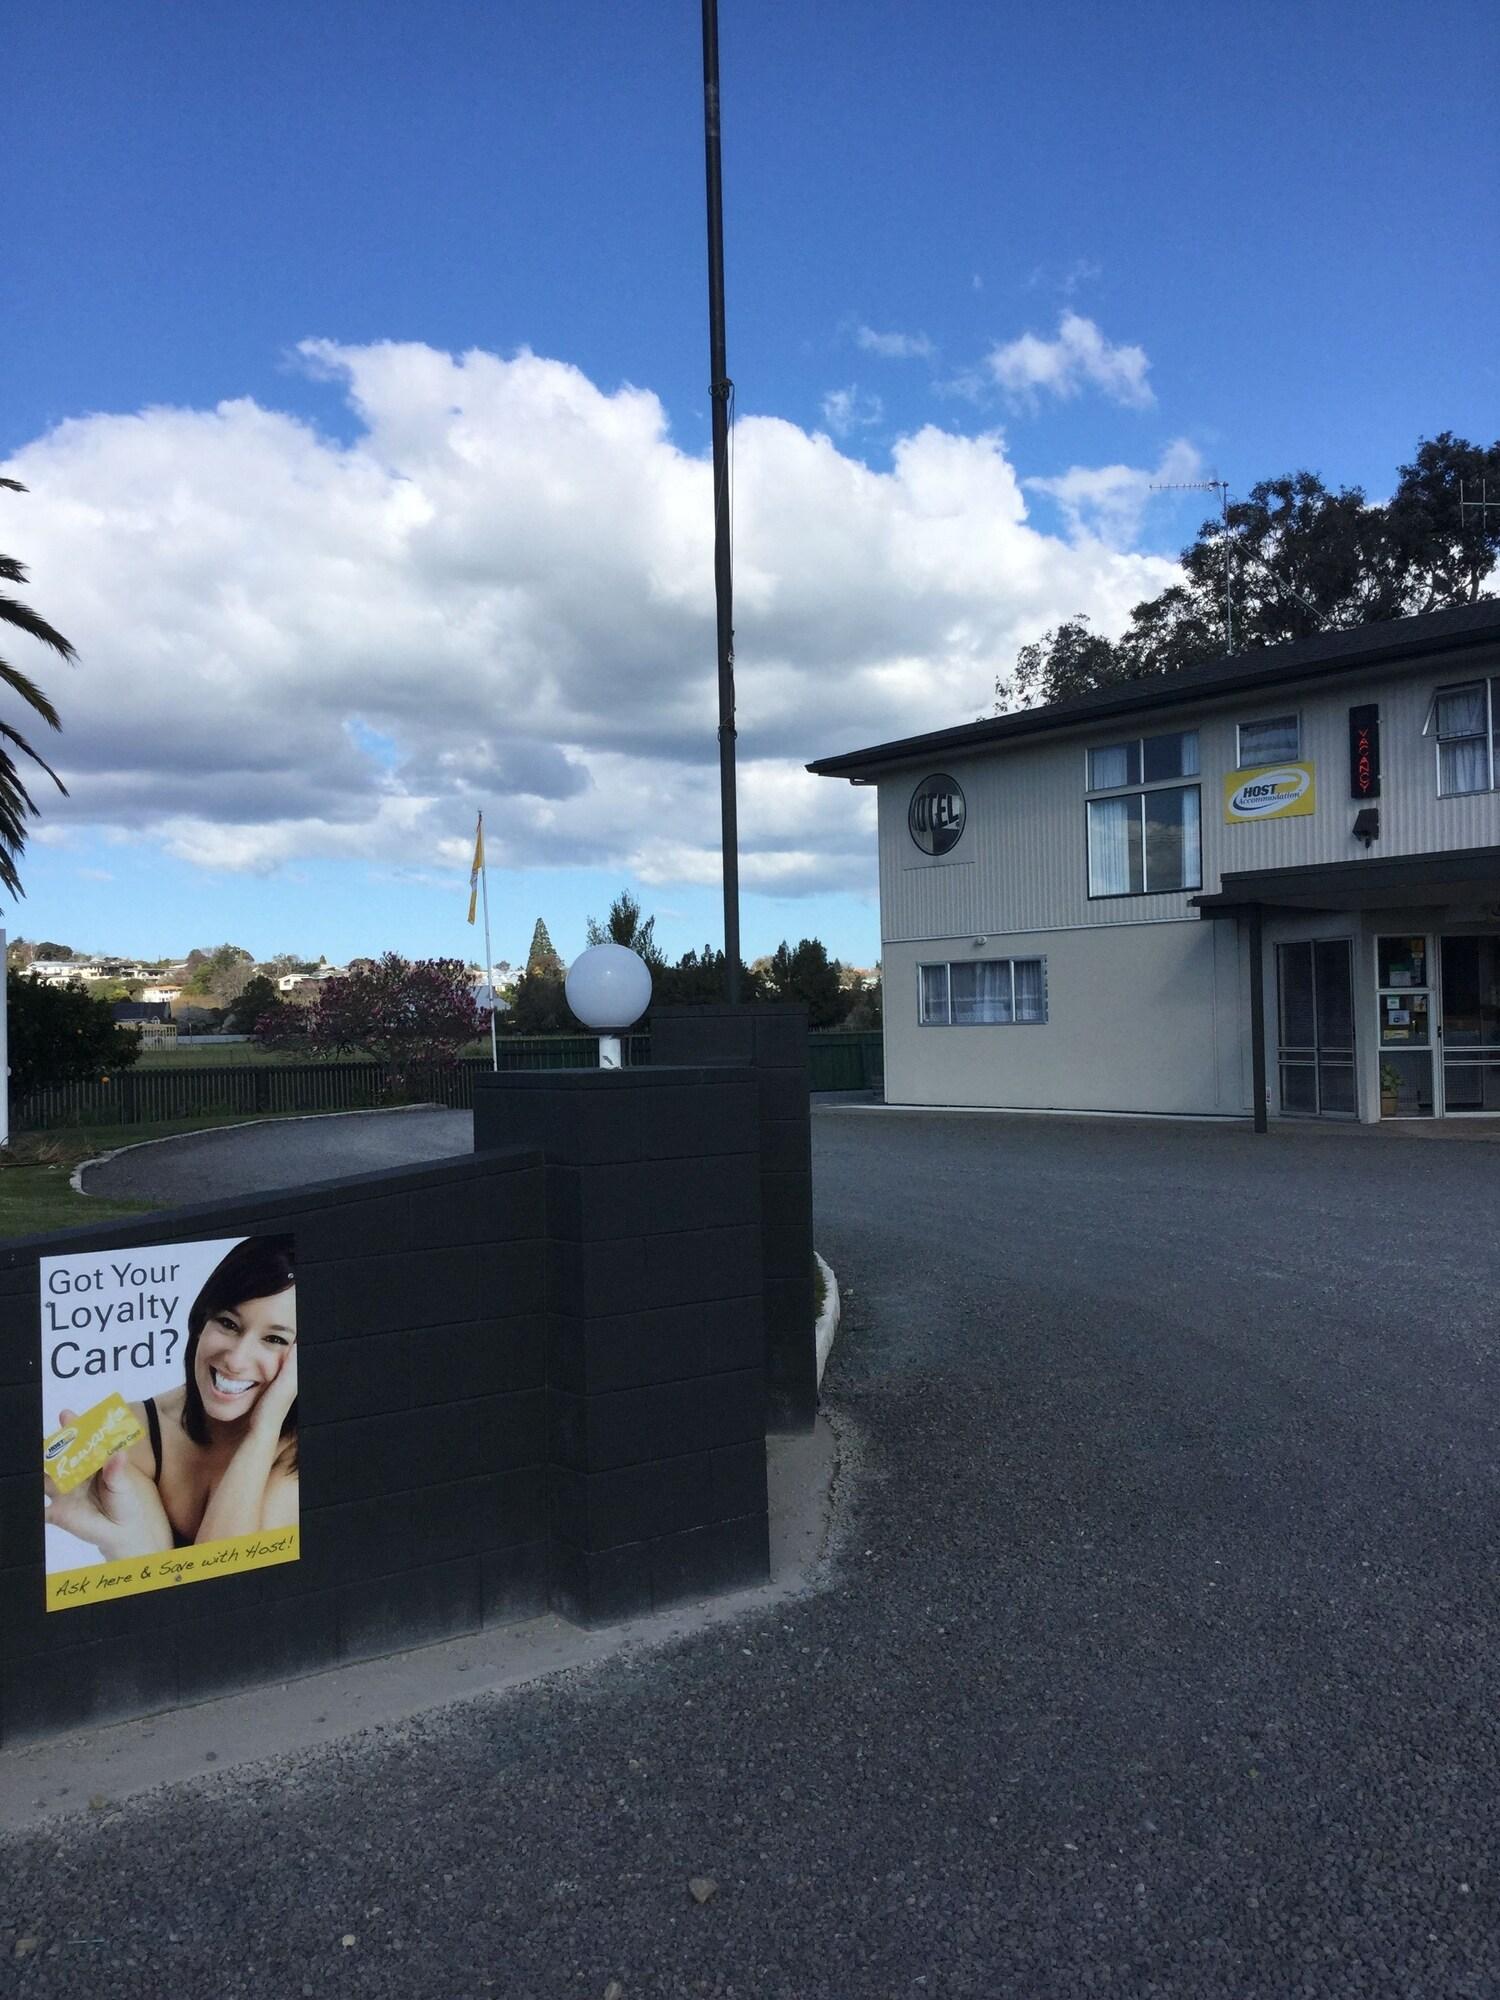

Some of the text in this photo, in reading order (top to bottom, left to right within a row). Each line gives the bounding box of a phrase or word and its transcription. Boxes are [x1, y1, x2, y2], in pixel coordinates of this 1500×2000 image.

[1243, 783, 1278, 798] HOST
[48, 1262, 180, 1295] Got Your
[50, 1292, 179, 1332] Loyalty
[51, 1328, 179, 1379] Card?
[48, 1439, 65, 1453] HOST
[56, 1535, 294, 1596] Ask here & Save with Host!
